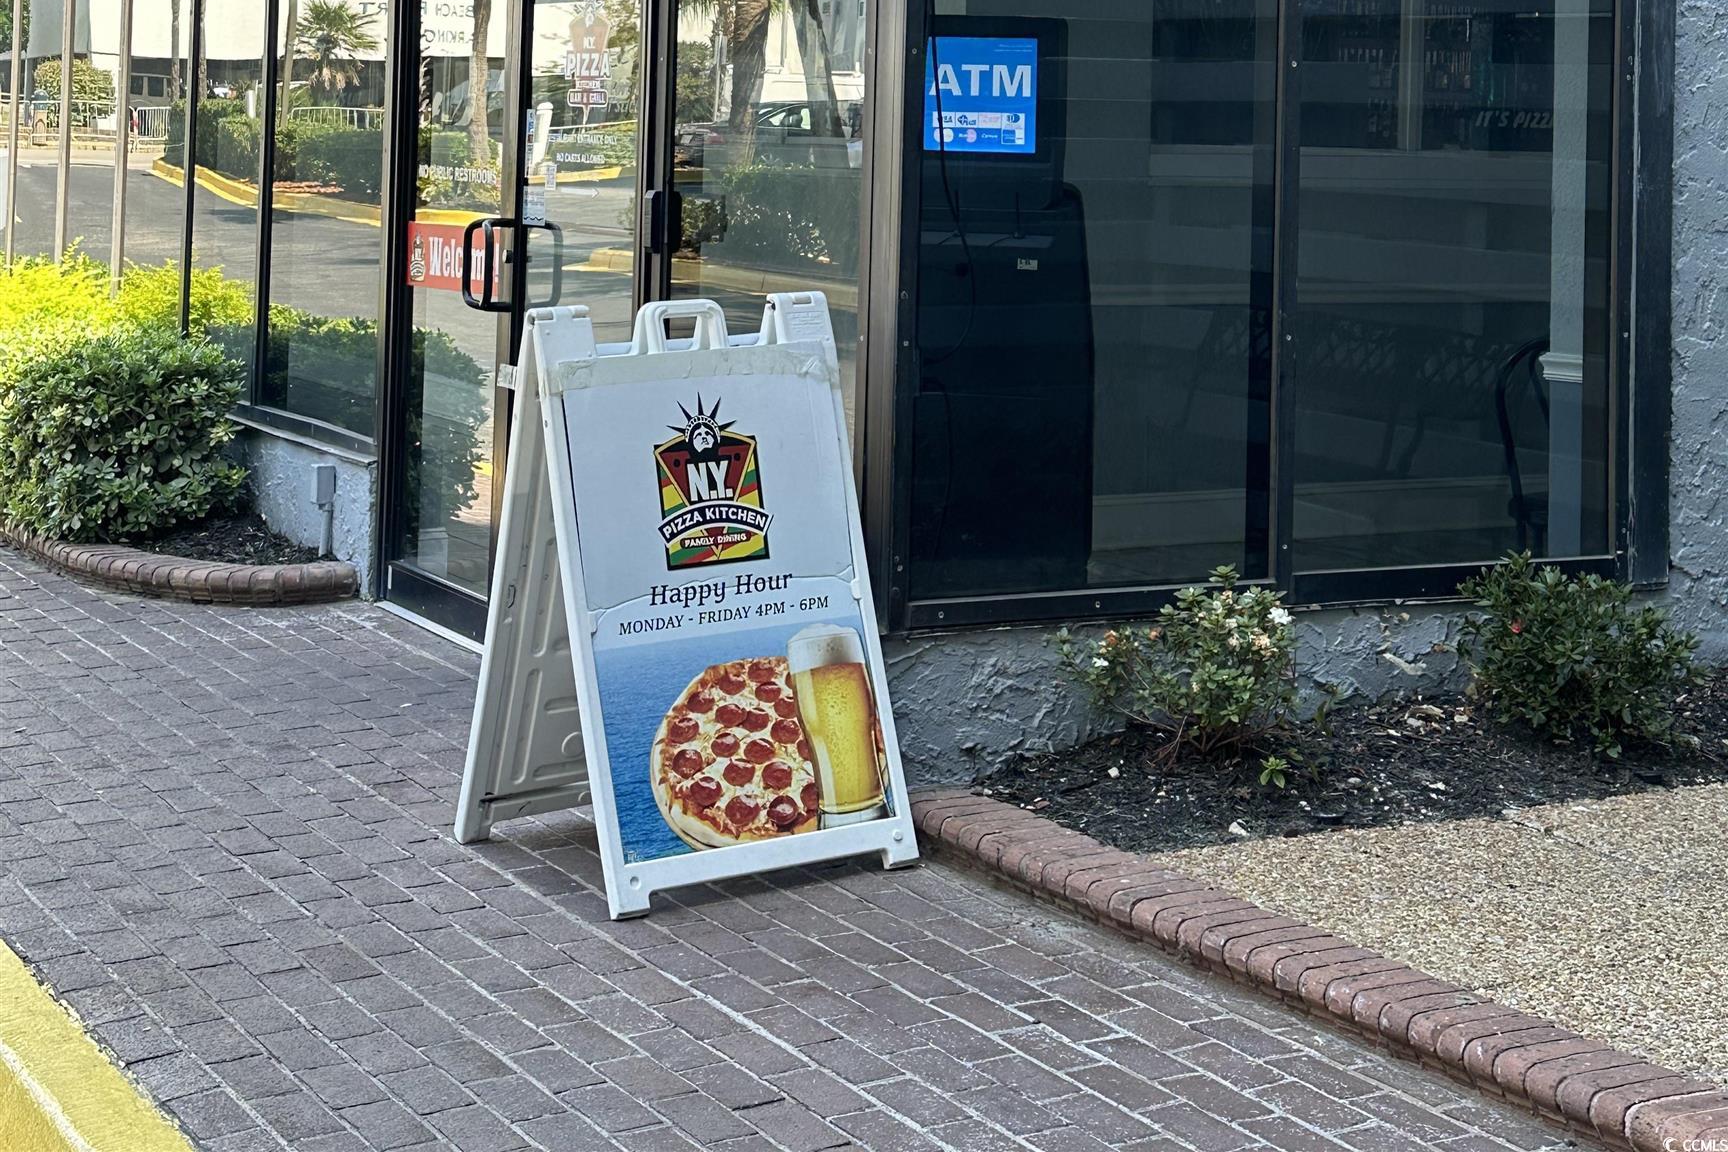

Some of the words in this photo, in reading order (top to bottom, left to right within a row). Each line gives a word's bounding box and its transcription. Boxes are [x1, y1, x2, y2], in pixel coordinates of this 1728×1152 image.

[565, 51, 612, 79] PIZZA
[928, 63, 1032, 98] ATM
[1475, 111, 1510, 128] IT'S
[1513, 111, 1553, 129] PIZZ
[429, 165, 455, 181] PUBLIC
[454, 166, 497, 184] RESTROOMS
[428, 235, 500, 283] Welcm!
[686, 459, 734, 501] N.Y.
[662, 512, 703, 539] PIZZA
[705, 507, 766, 528] KITCHEN
[684, 537, 715, 548] FAMILY
[717, 532, 748, 545] DINING
[650, 581, 726, 608] Happy
[735, 573, 793, 596] Hour
[619, 615, 685, 636] MONDAY
[698, 606, 752, 625] FRIDAY
[755, 601, 786, 617] 4PM
[799, 596, 830, 611] 6PM
